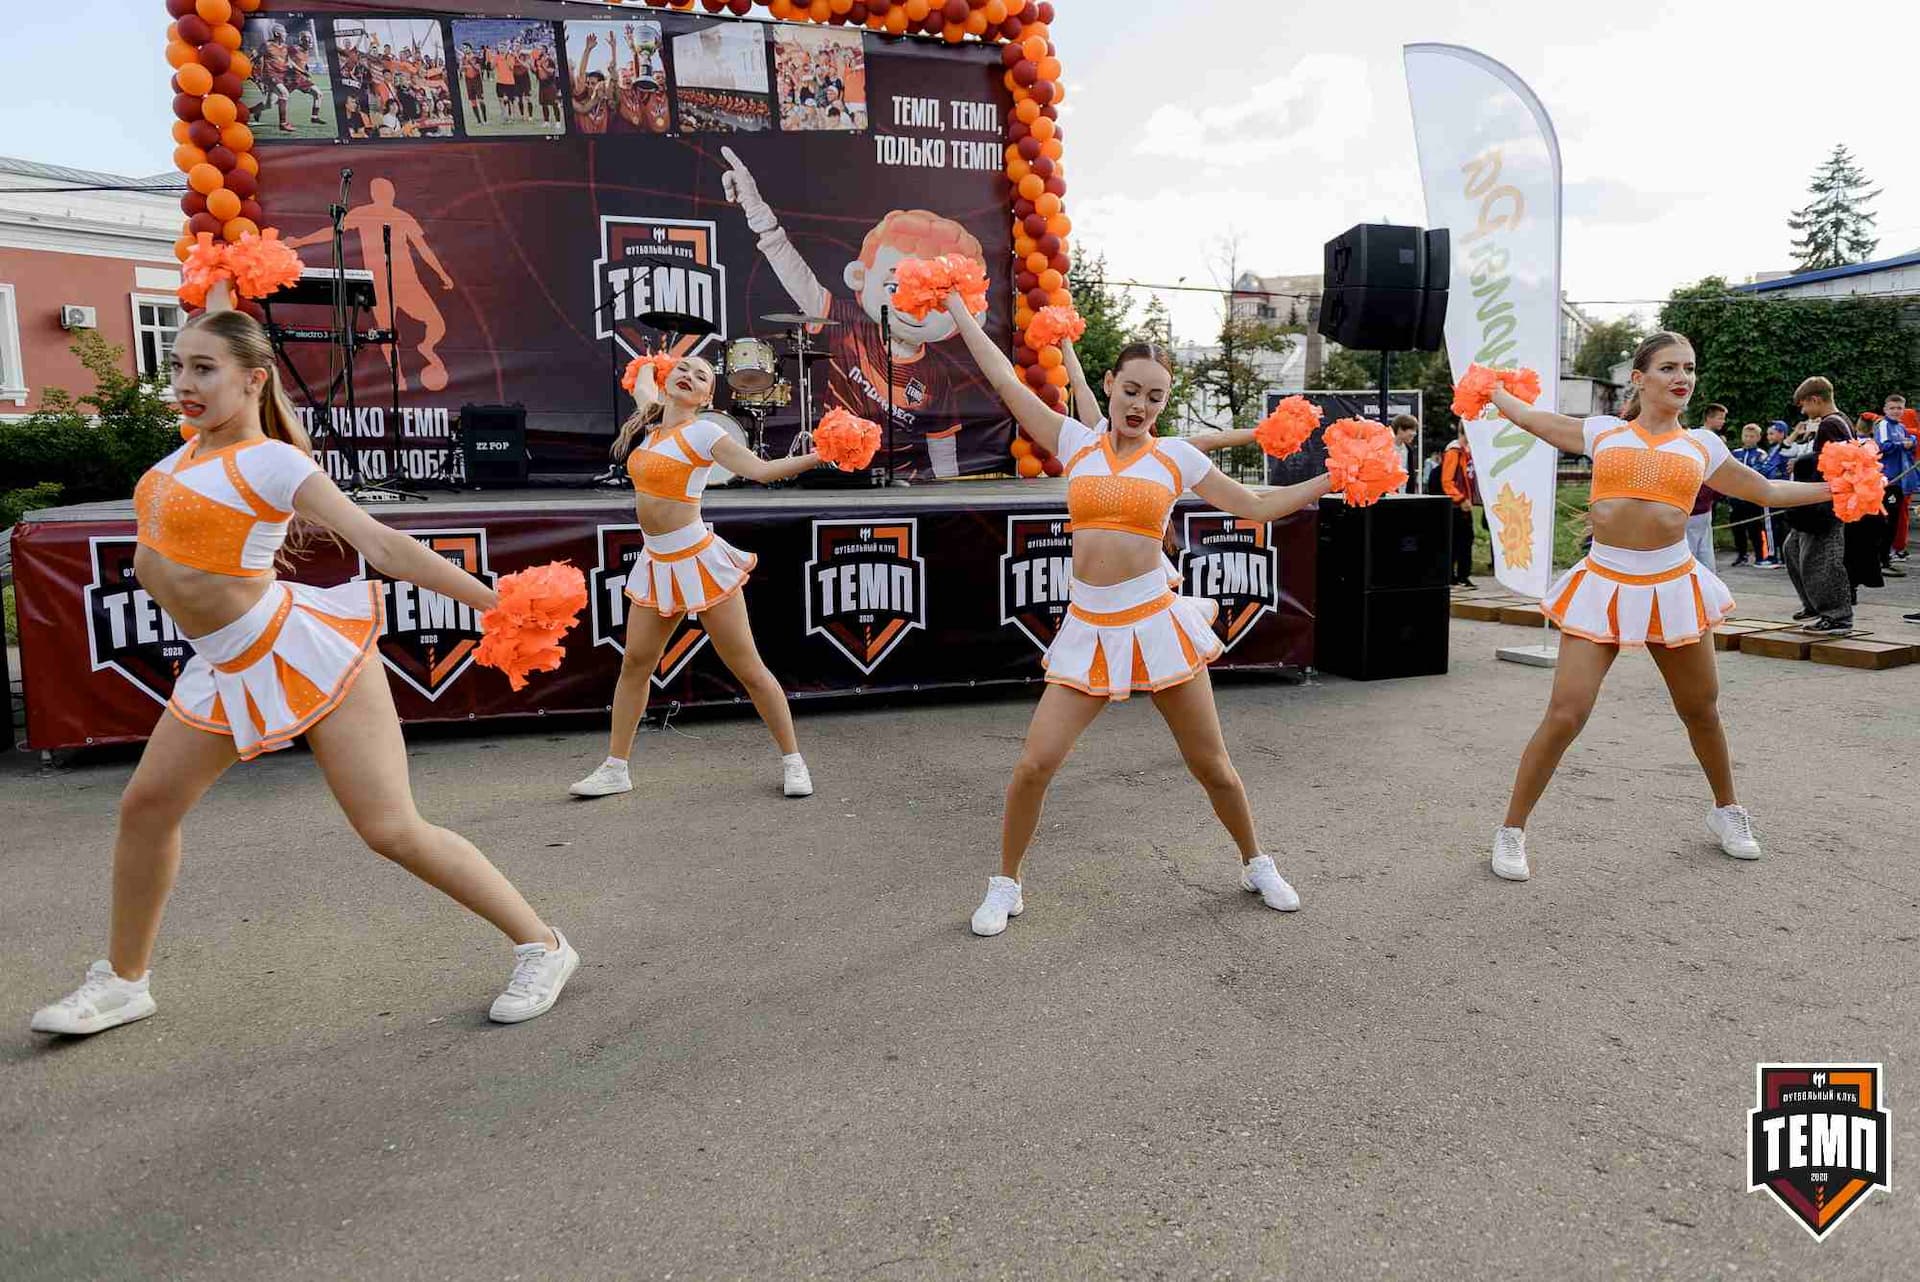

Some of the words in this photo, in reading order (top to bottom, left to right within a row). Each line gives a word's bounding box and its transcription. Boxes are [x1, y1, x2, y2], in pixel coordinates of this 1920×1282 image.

[892, 96, 945, 132] ТЕМП,
[950, 101, 1002, 135] ТЕМП,
[874, 135, 946, 168] ТОЛЬКО
[950, 140, 1003, 170] ТЕМП!
[608, 266, 713, 323] ТЕМП
[818, 563, 913, 616] ТЕМП
[1012, 557, 1074, 608] ТЕМ
[1190, 552, 1268, 599] ТЕМП
[162, 646, 183, 657] 2020
